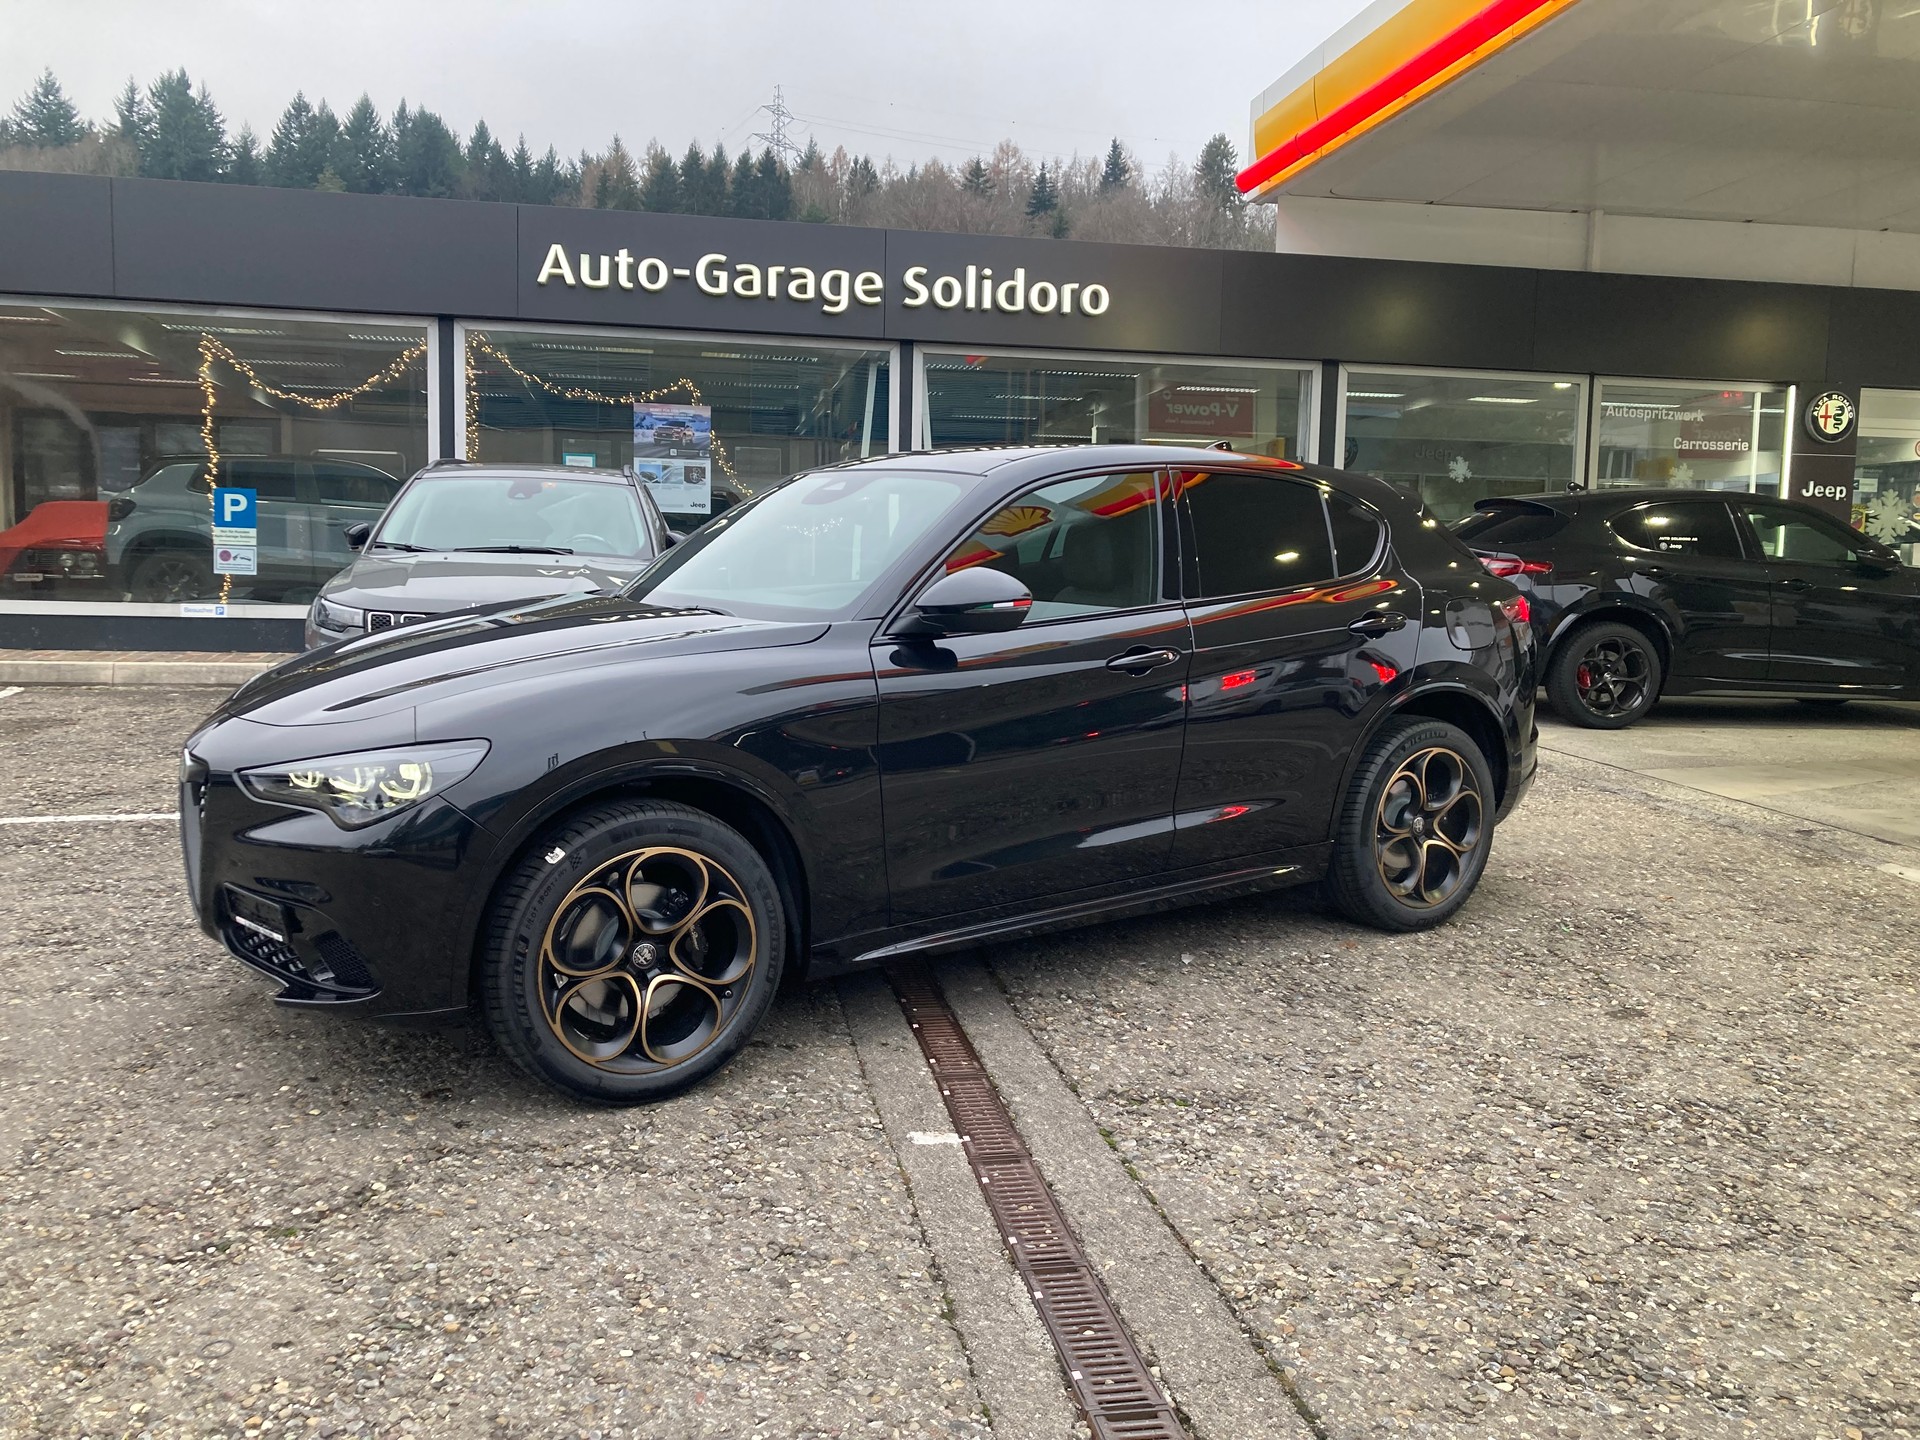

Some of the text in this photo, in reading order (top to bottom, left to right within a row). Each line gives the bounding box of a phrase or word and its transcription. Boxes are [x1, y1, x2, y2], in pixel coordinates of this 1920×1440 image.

[536, 243, 1110, 316] Auto-Garage Solidoro
[1606, 406, 1704, 422] Autospritzwerk
[1813, 394, 1854, 419] ALFA ROMEO
[1673, 437, 1749, 451] Carrosserie
[1802, 480, 1847, 501] Jeep
[224, 493, 248, 522] P
